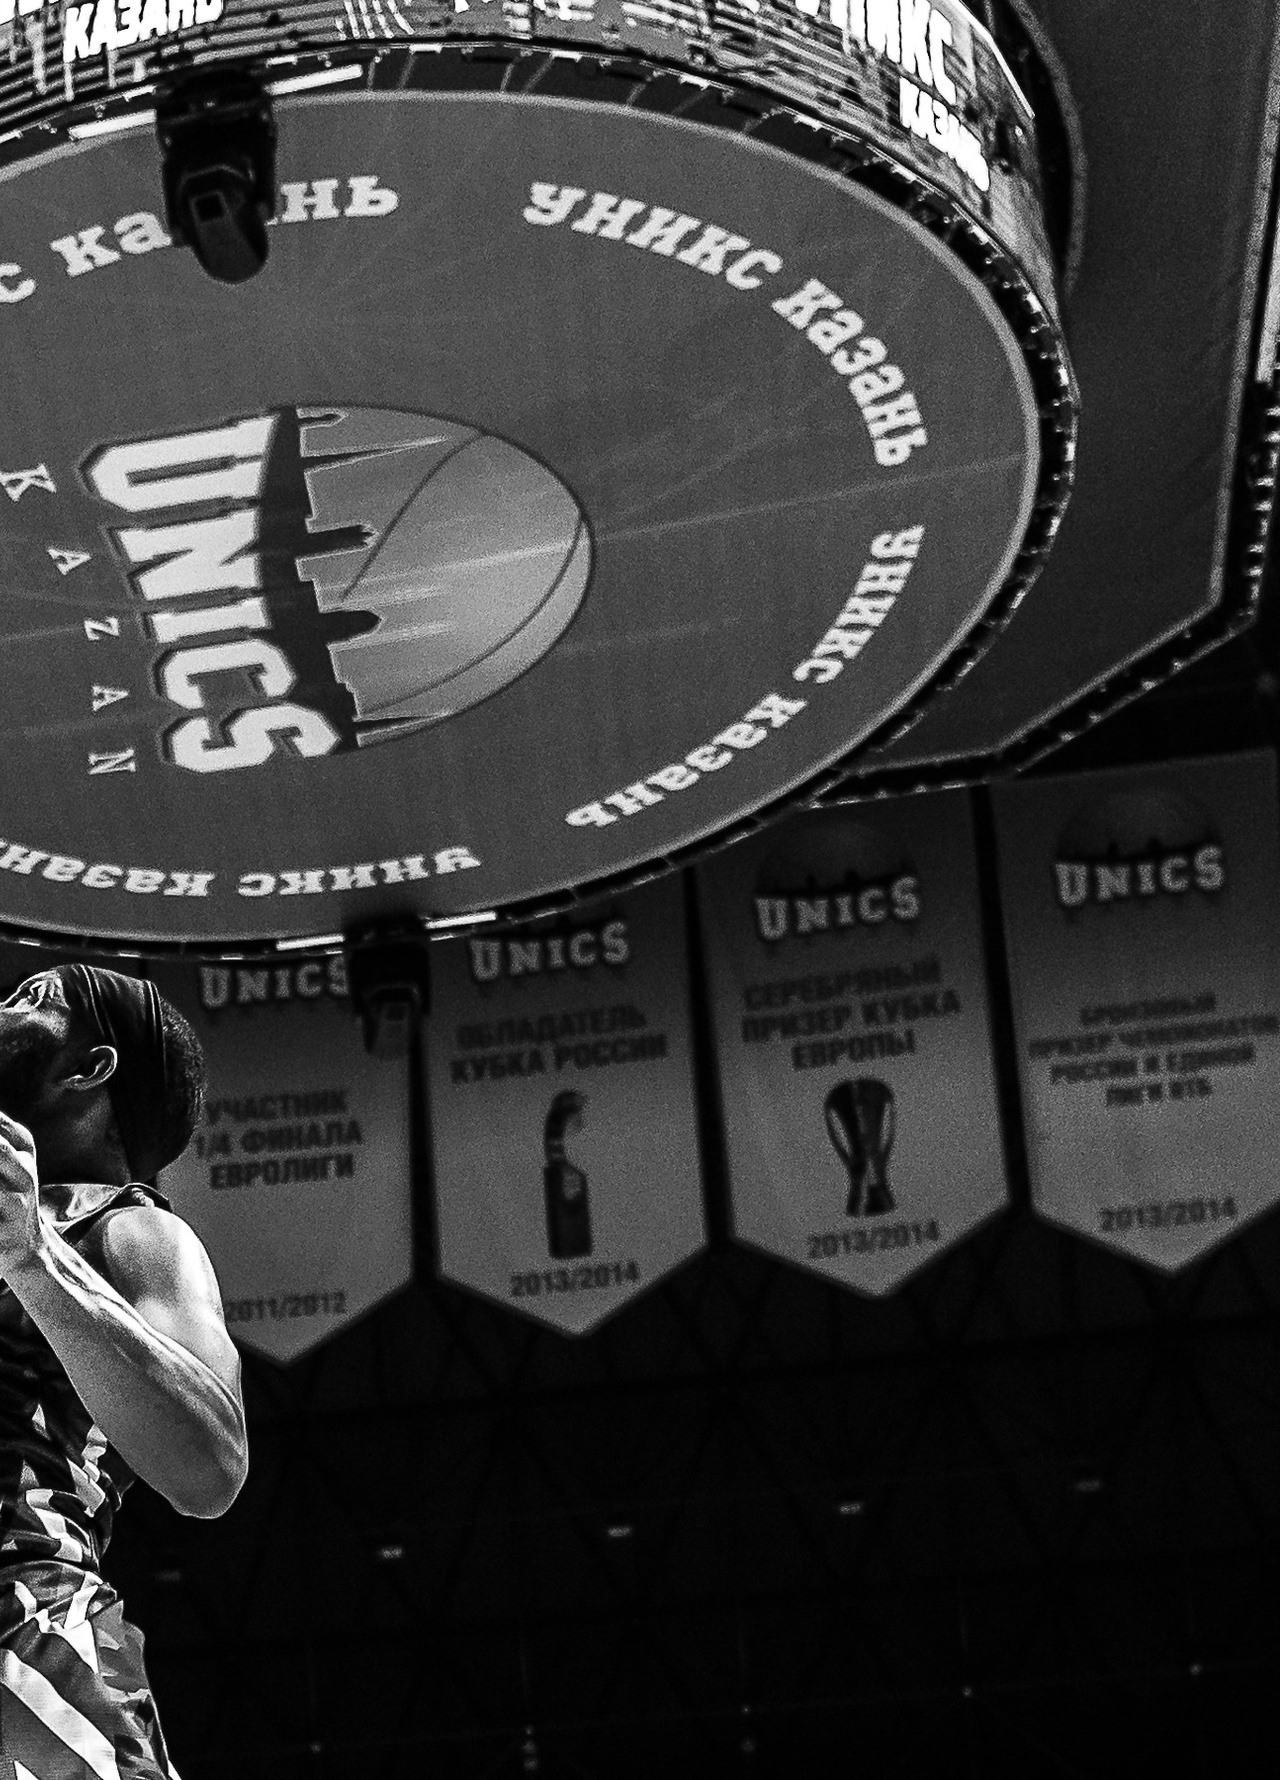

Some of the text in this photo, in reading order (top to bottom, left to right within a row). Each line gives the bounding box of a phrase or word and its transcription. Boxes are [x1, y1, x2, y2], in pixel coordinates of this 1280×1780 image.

[80, 413, 342, 774] UNICS
[1054, 845, 1224, 906] UNICS
[753, 875, 920, 940] UNICS
[469, 921, 630, 981] UNICS
[200, 955, 349, 1008] UNICS
[449, 1033, 668, 1085] КУБКА РОССИИ
[205, 1089, 349, 1127] УЧАСТНИК
[240, 1120, 364, 1154] ФИНАЛА
[209, 1153, 355, 1190] ЕВРОЛИГИ
[510, 1260, 640, 1297] 2013/2014
